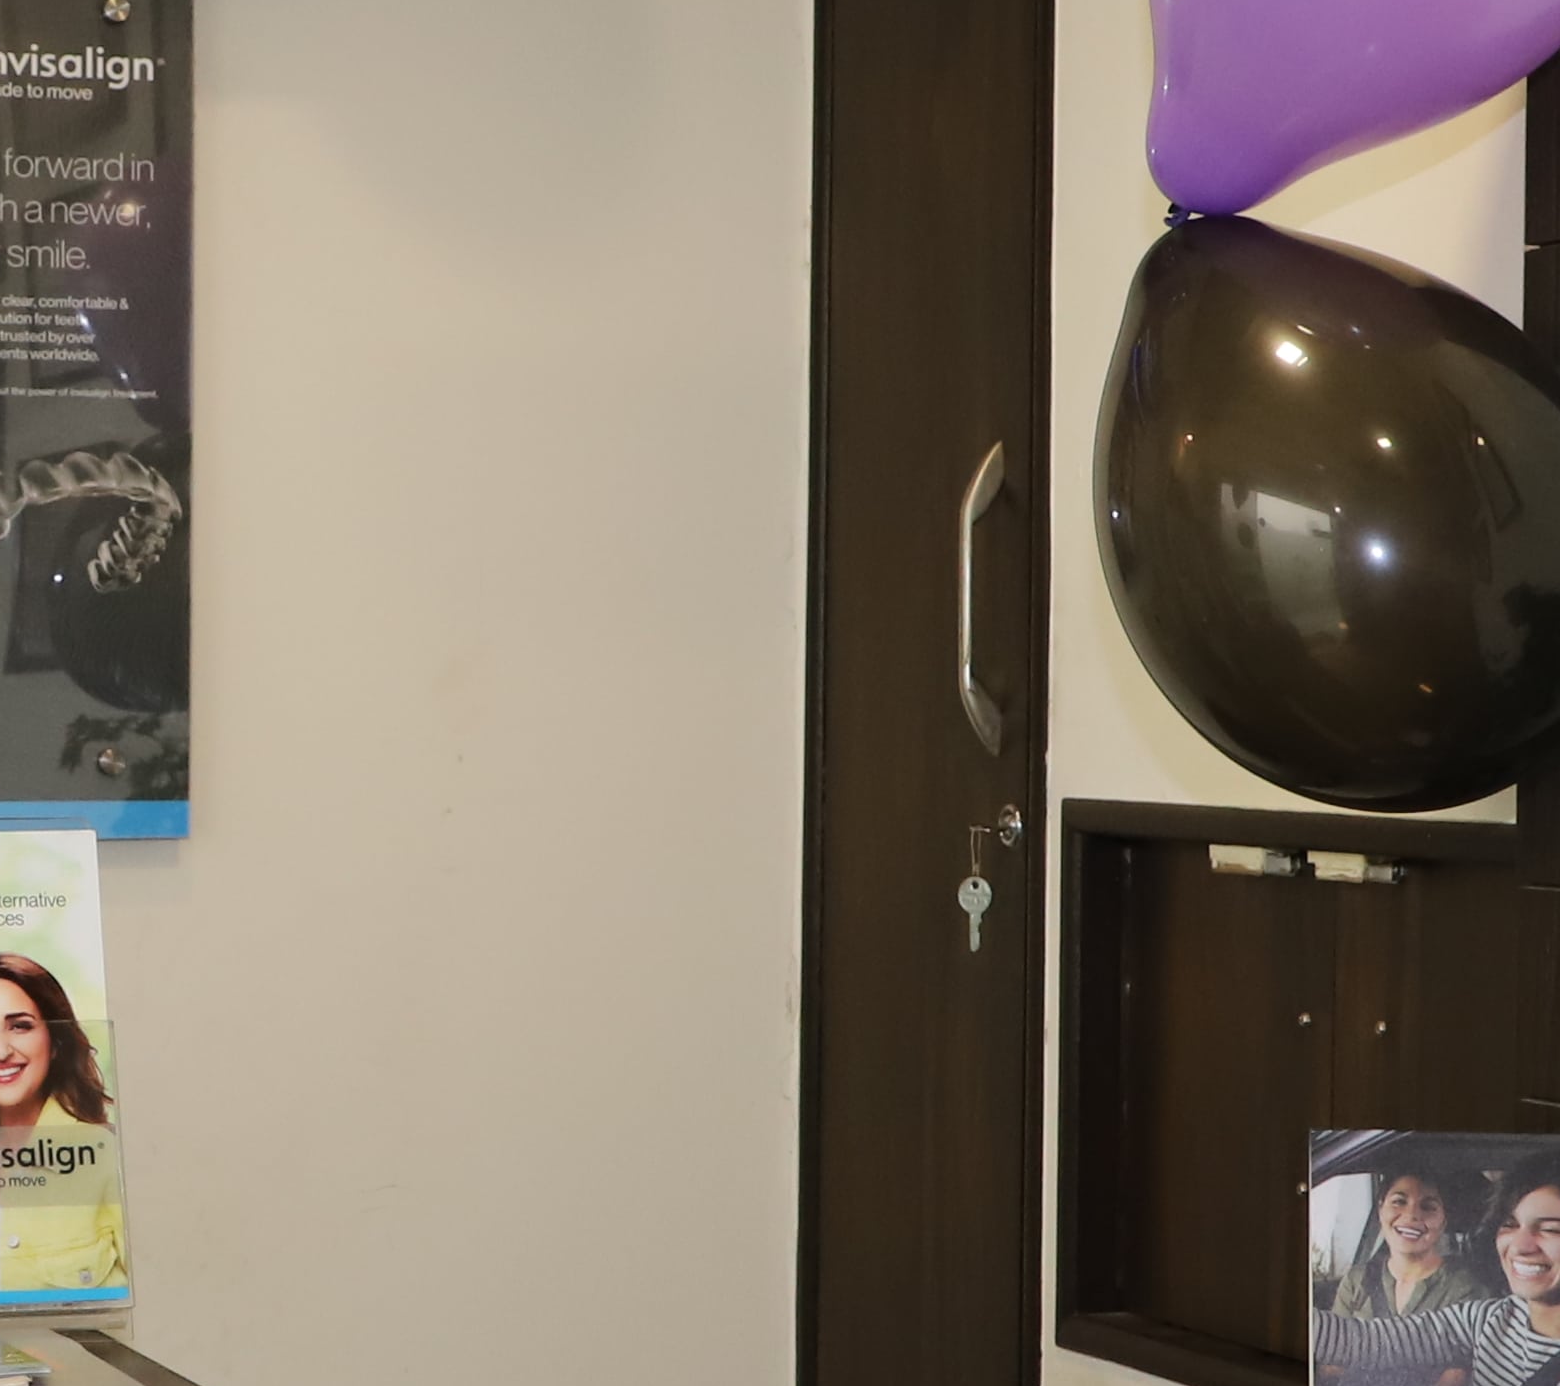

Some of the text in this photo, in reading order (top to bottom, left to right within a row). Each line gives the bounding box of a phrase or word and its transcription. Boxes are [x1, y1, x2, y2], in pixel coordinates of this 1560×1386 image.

[27, 83, 44, 99] to
[47, 87, 93, 101] move
[3, 147, 124, 182] forward
[130, 153, 155, 182] in
[24, 201, 44, 224] a
[50, 202, 151, 230] newer,
[6, 239, 91, 270] smile.
[2, 294, 129, 311] clear, comfortable &
[34, 313, 52, 327] for
[0, 328, 47, 344] trusted
[48, 330, 64, 347] by
[65, 332, 96, 345] over
[30, 348, 100, 363] worldwide.
[9, 1175, 47, 1188] move
